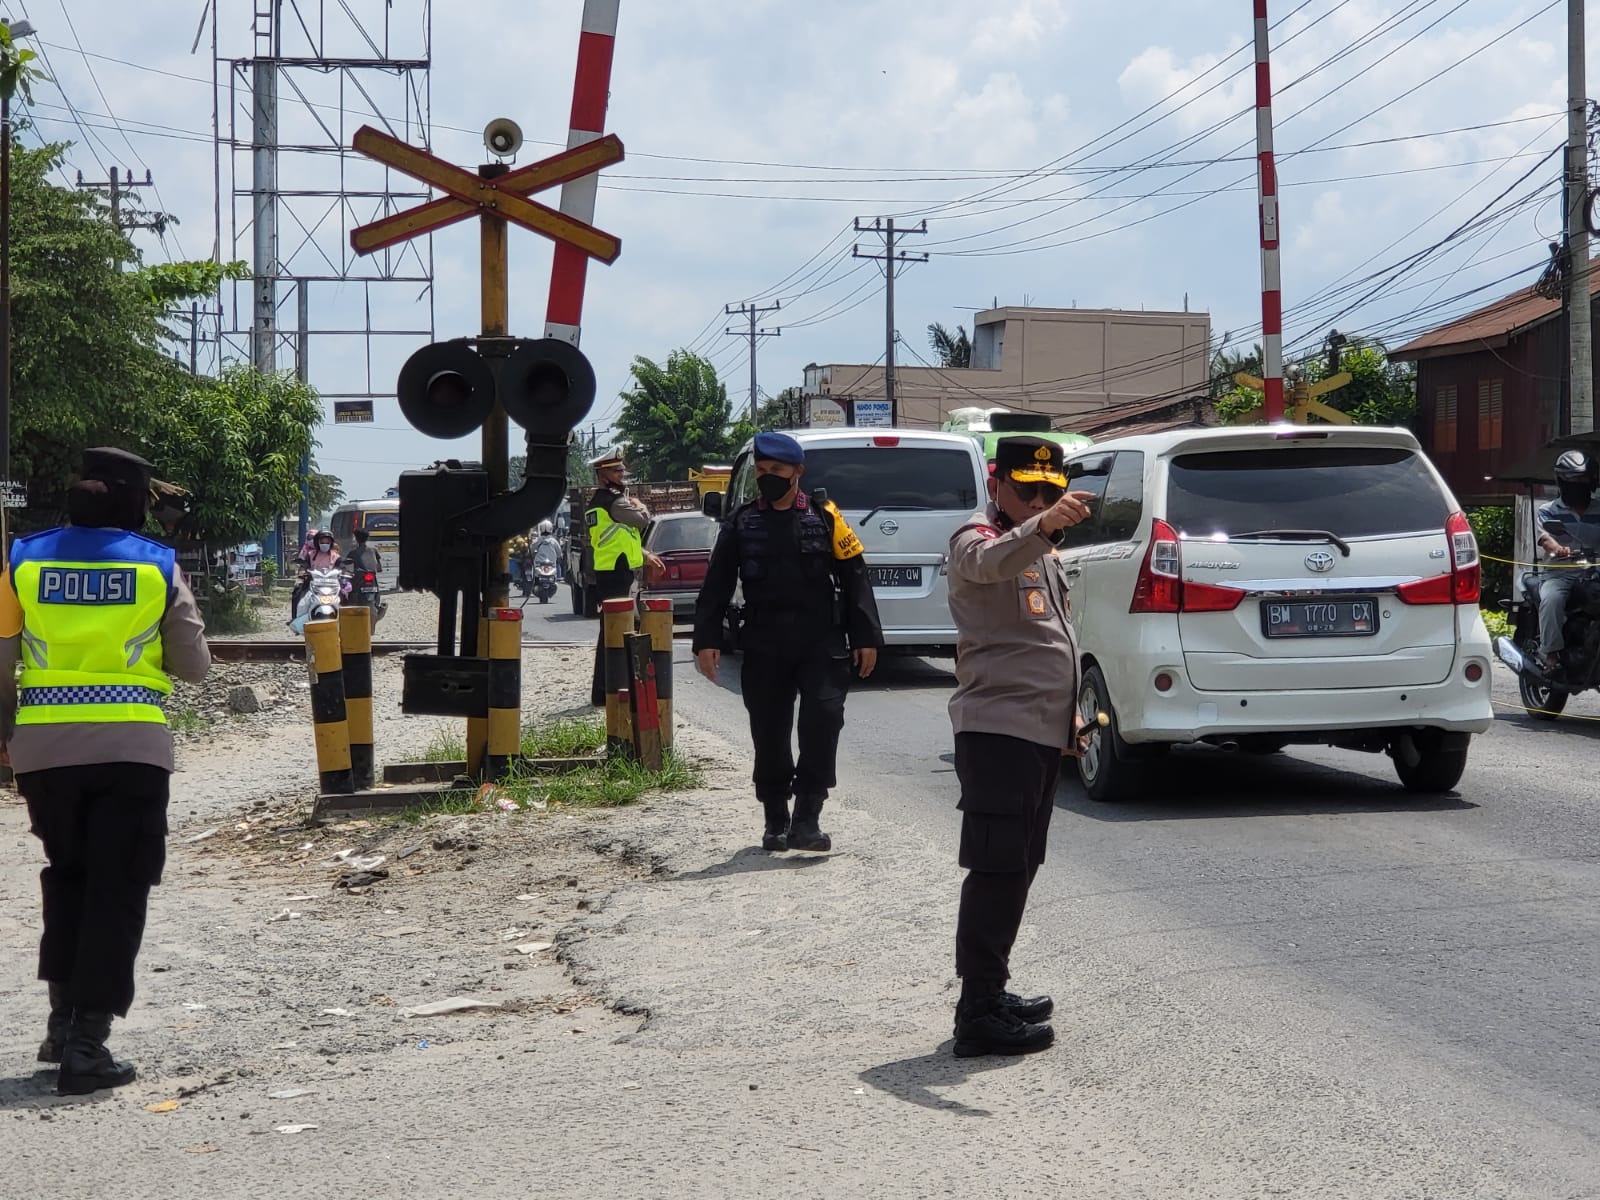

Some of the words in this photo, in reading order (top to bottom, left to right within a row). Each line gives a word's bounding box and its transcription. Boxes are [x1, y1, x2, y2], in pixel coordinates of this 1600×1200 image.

[878, 569, 899, 580] 1774
[44, 572, 131, 600] POLISI
[1270, 606, 1291, 625] BM
[1304, 604, 1337, 622] 1770
[1352, 603, 1370, 621] CX
